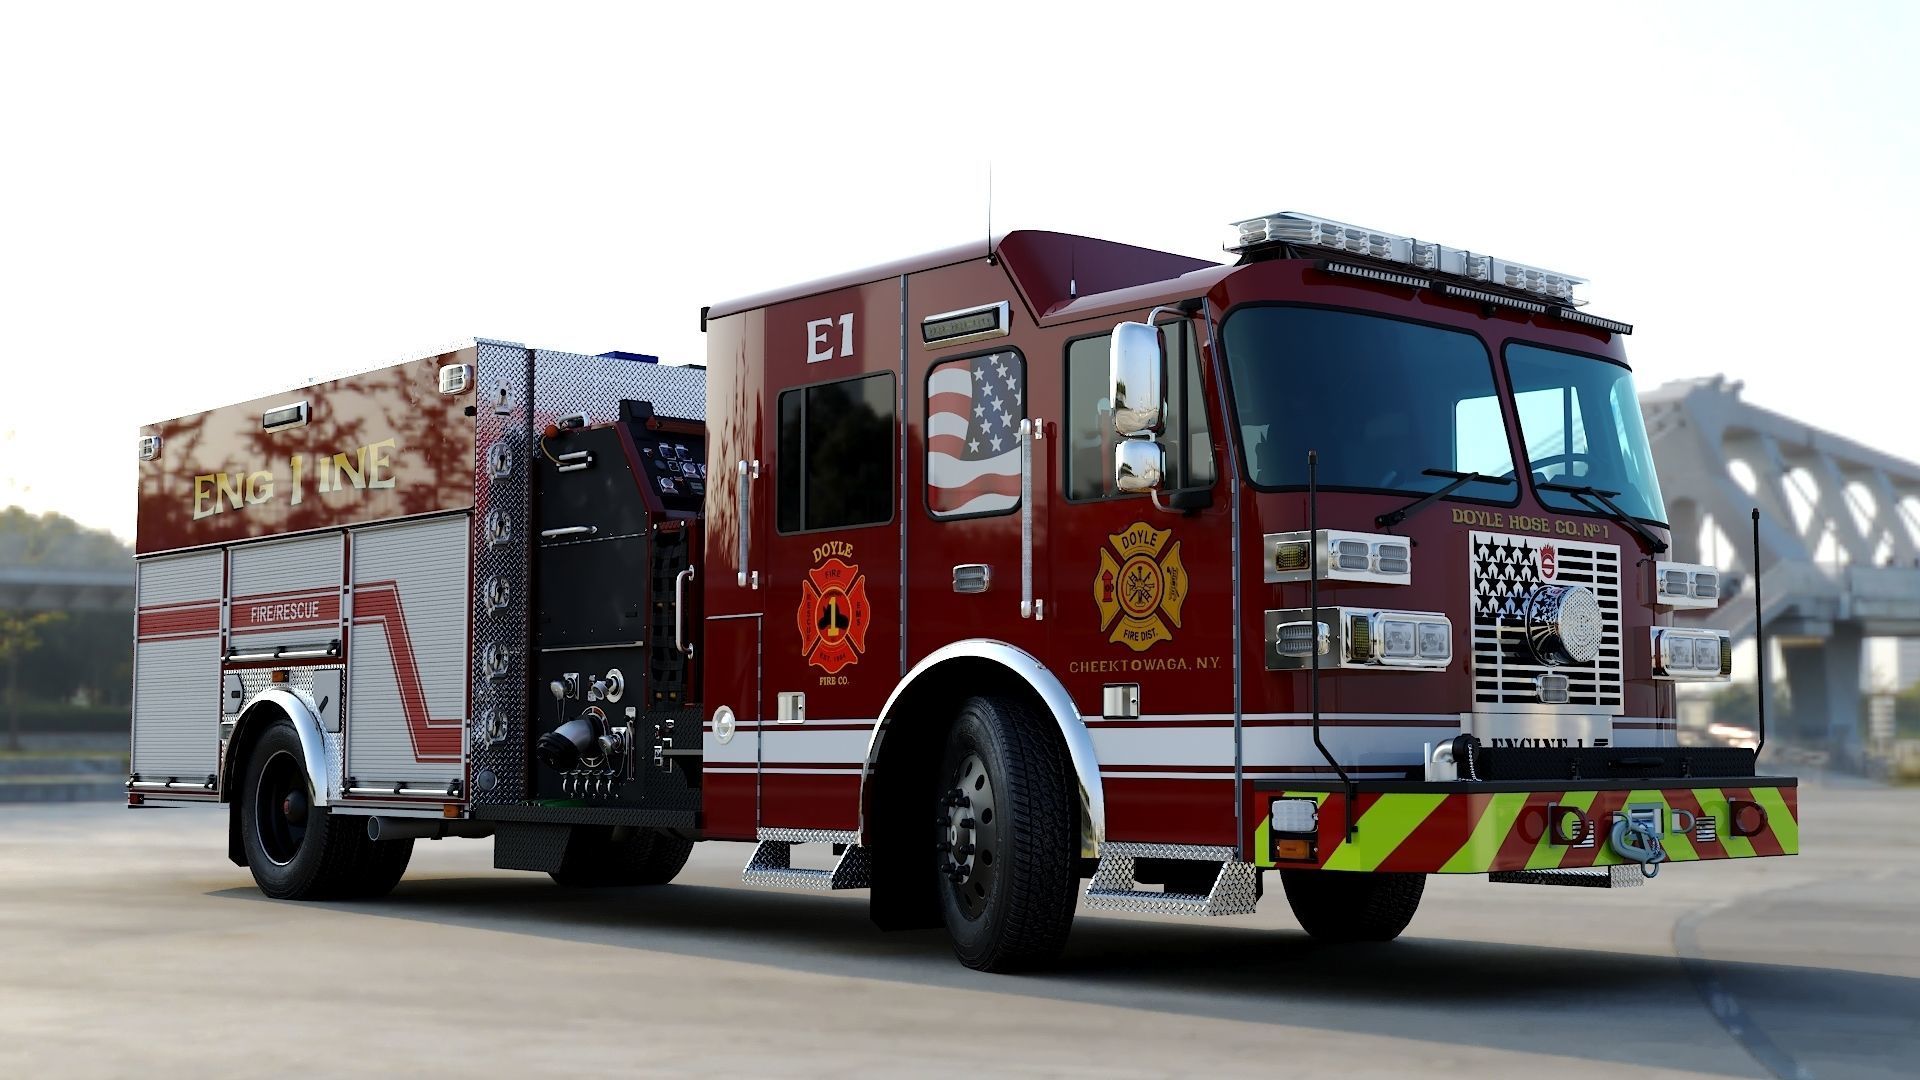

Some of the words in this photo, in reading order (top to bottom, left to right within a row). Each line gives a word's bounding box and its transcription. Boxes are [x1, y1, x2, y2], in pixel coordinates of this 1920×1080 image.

[806, 312, 854, 364] E1
[193, 470, 274, 521] ENG
[290, 455, 303, 506] 1
[318, 438, 396, 493] INE
[1451, 508, 1503, 528] DOYLE
[1509, 515, 1551, 533] HOSE
[1555, 519, 1581, 536] CO.
[1121, 530, 1158, 550] DOYLE
[812, 541, 854, 563] DOYLE
[824, 569, 841, 579] FIRE
[251, 601, 320, 623] FIRE/RESCUE
[828, 596, 840, 637] 1
[1123, 629, 1139, 642] FIRE
[1141, 627, 1159, 641] DIST.
[1069, 657, 1192, 673] CHEEKTOWAGA,
[819, 676, 837, 686] FIRE
[837, 675, 850, 686] CO.
